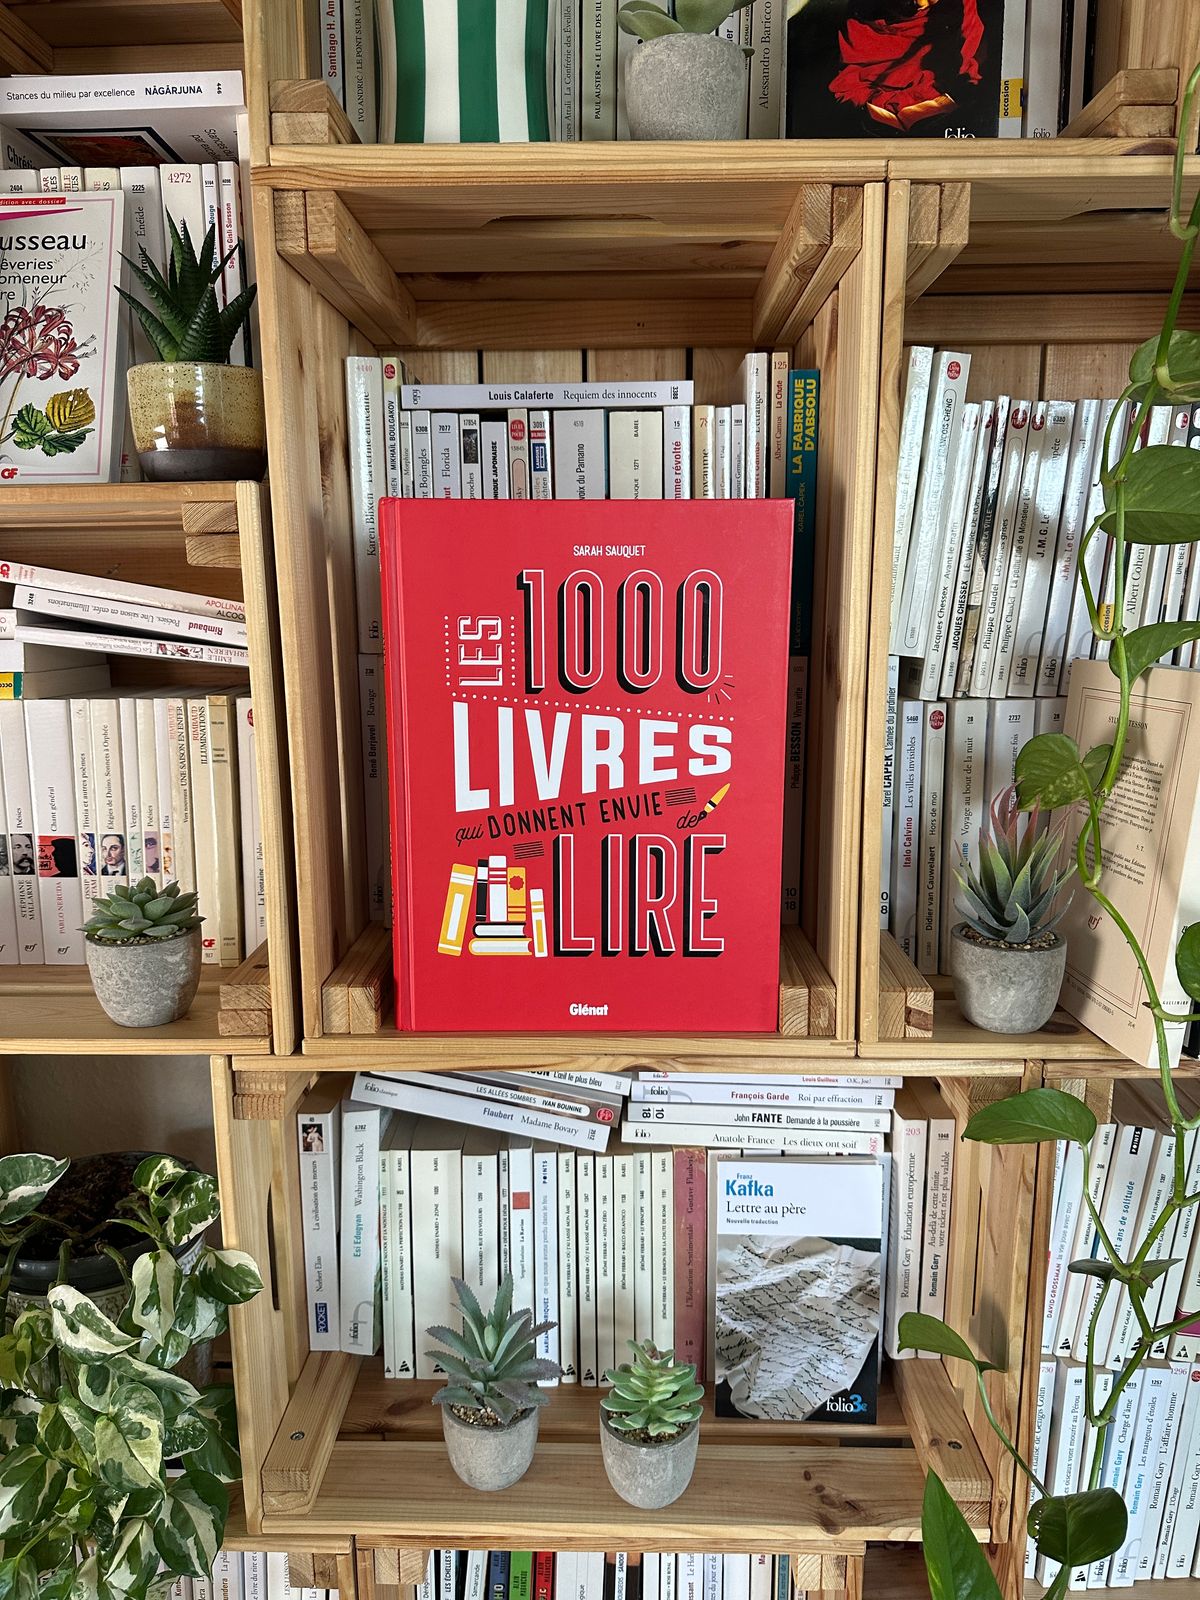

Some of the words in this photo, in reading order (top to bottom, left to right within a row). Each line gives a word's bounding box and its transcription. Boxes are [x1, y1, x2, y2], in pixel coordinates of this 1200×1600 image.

[760, 1, 772, 44] Baricco
[327, 33, 338, 78] Santiago
[563, 49, 572, 85] Confrérie
[759, 47, 771, 109] Alessandro
[6, 90, 39, 103] Stances
[40, 90, 51, 100] du
[52, 89, 77, 99] milieu
[78, 90, 91, 102] par
[93, 87, 135, 99] excellence
[132, 184, 145, 192] 2225
[167, 172, 192, 183] 4272
[137, 205, 146, 237] Énéide
[774, 361, 787, 370] 125
[488, 390, 512, 401] Louis
[513, 389, 554, 401] Calaferte
[562, 389, 600, 402] Requiem
[601, 389, 615, 399] des
[617, 389, 657, 399] innocents
[387, 400, 396, 441] BOULGAKOV
[791, 378, 805, 450] FABRIQUE
[805, 378, 816, 451] D'ABSOLU
[388, 442, 397, 471] MIKHAÏL
[402, 447, 410, 476] Morphine
[418, 448, 430, 489] Bojangles
[440, 447, 451, 478] Florida
[490, 440, 498, 478] JAPONAISE
[575, 443, 585, 473] Pamano
[671, 441, 681, 476] révolté
[792, 455, 803, 474] LA
[1, 467, 19, 479] GF
[364, 492, 376, 525] Blixen
[1018, 502, 1030, 534] Monsieur
[366, 527, 377, 557] Karen
[573, 545, 603, 556] SARAH
[605, 544, 646, 558] SAUQUET
[1131, 548, 1145, 581] Cohen
[47, 598, 90, 614] Illuminations
[935, 586, 949, 619] Chessex
[956, 580, 968, 615] CHESSEX
[987, 583, 1000, 615] Claudel
[1004, 596, 1016, 624] Claudel
[1126, 583, 1140, 615] Albert
[120, 610, 139, 620] saison
[188, 621, 223, 636] Rimbaud
[516, 568, 723, 695] 1000
[931, 620, 944, 653] Jacques
[951, 616, 964, 651] JACQUES
[983, 616, 997, 650] Philippe
[1000, 624, 1012, 654] Philippe
[457, 615, 503, 687] LES
[1017, 657, 1029, 678] folio
[1044, 658, 1057, 679] folio
[365, 688, 378, 717] Ravage
[886, 686, 897, 715] jardinier
[176, 705, 185, 731] ENFER
[191, 705, 200, 741] RIMBAUD
[198, 705, 208, 765] ILLUMINATIONS
[790, 722, 802, 763] BESSON
[178, 742, 187, 770] SAISON
[452, 701, 732, 813] LIVRES
[906, 736, 916, 772] invisibles
[905, 772, 915, 792] villes
[47, 786, 58, 811] général
[49, 812, 58, 832] Chant
[455, 823, 484, 847] qui
[487, 802, 586, 839] DONNENT
[599, 791, 663, 824] ENVIE
[902, 817, 913, 847] Calvino
[962, 807, 973, 836] Voyage
[902, 849, 913, 868] Italo
[926, 845, 936, 890] Cauwelaert
[17, 880, 26, 918] STÉPHANE
[25, 879, 35, 921] MALLARMÉ
[55, 881, 64, 911] NERUDA
[552, 833, 727, 958] LIRE
[57, 912, 66, 934] PABLO
[925, 907, 934, 931] Didier
[202, 939, 216, 948] GF
[569, 1003, 609, 1016] Glénat
[364, 1082, 380, 1094] folio
[475, 1085, 487, 1094] LES
[509, 1092, 537, 1104] SOMBRES
[556, 1102, 583, 1114] BOUNINE
[649, 1085, 668, 1096] folio
[730, 1089, 764, 1102] François
[765, 1091, 790, 1101] Garde
[826, 1093, 863, 1104] effraction
[482, 1107, 514, 1121] Flaubert
[520, 1114, 552, 1130] Madame
[553, 1120, 579, 1136] Bovary
[734, 1112, 750, 1123] John
[751, 1112, 783, 1123] FANTE
[785, 1114, 815, 1125] Demande
[829, 1117, 860, 1129] poussière
[355, 1143, 364, 1163] Black
[712, 1133, 746, 1144] Anatole
[747, 1134, 776, 1145] France
[1131, 1130, 1141, 1154] POINTS
[1166, 1142, 1174, 1158] BABEL
[686, 1156, 694, 1186] Flaubert
[906, 1153, 917, 1200] européenne
[940, 1151, 950, 1178] valable
[354, 1165, 365, 1207] Washington
[686, 1186, 695, 1215] Gustave
[725, 1179, 774, 1197] Kafka
[1121, 1181, 1135, 1214] solitude
[311, 1191, 320, 1221] civilisation
[726, 1200, 762, 1213] Lettre
[764, 1204, 778, 1214] au
[781, 1203, 806, 1218] père
[353, 1214, 363, 1245] Edugyan
[901, 1202, 914, 1241] Éducation
[928, 1220, 938, 1247] Au-delà
[686, 1224, 695, 1267] Sentimentale
[901, 1247, 913, 1268] Gary
[930, 1254, 941, 1271] Gary
[315, 1270, 324, 1293] Norbert
[900, 1268, 910, 1299] Romain
[929, 1271, 939, 1297] Romain
[1049, 1263, 1062, 1299] GROSSMAN
[316, 1303, 327, 1334] POCKET
[826, 1396, 854, 1413] folio
[1036, 1386, 1046, 1407] Cohn
[1070, 1395, 1080, 1414] Pérou
[1121, 1399, 1133, 1419] d'âme
[1144, 1396, 1158, 1424] d'étoiles
[1164, 1391, 1179, 1422] homme
[1034, 1408, 1048, 1435] Gengis
[1067, 1424, 1077, 1447] mourir
[1117, 1420, 1131, 1444] Charge
[1140, 1424, 1153, 1455] mangeurs
[1158, 1423, 1173, 1454] L'affaire
[1063, 1463, 1072, 1486] oiseaux
[1134, 1473, 1145, 1489] Gary
[1154, 1461, 1166, 1480] Gary
[1129, 1490, 1142, 1515] Romain
[1149, 1480, 1162, 1510] Romain
[443, 1555, 452, 1582] ÉCHELLES
[471, 1564, 481, 1598] Samarcande
